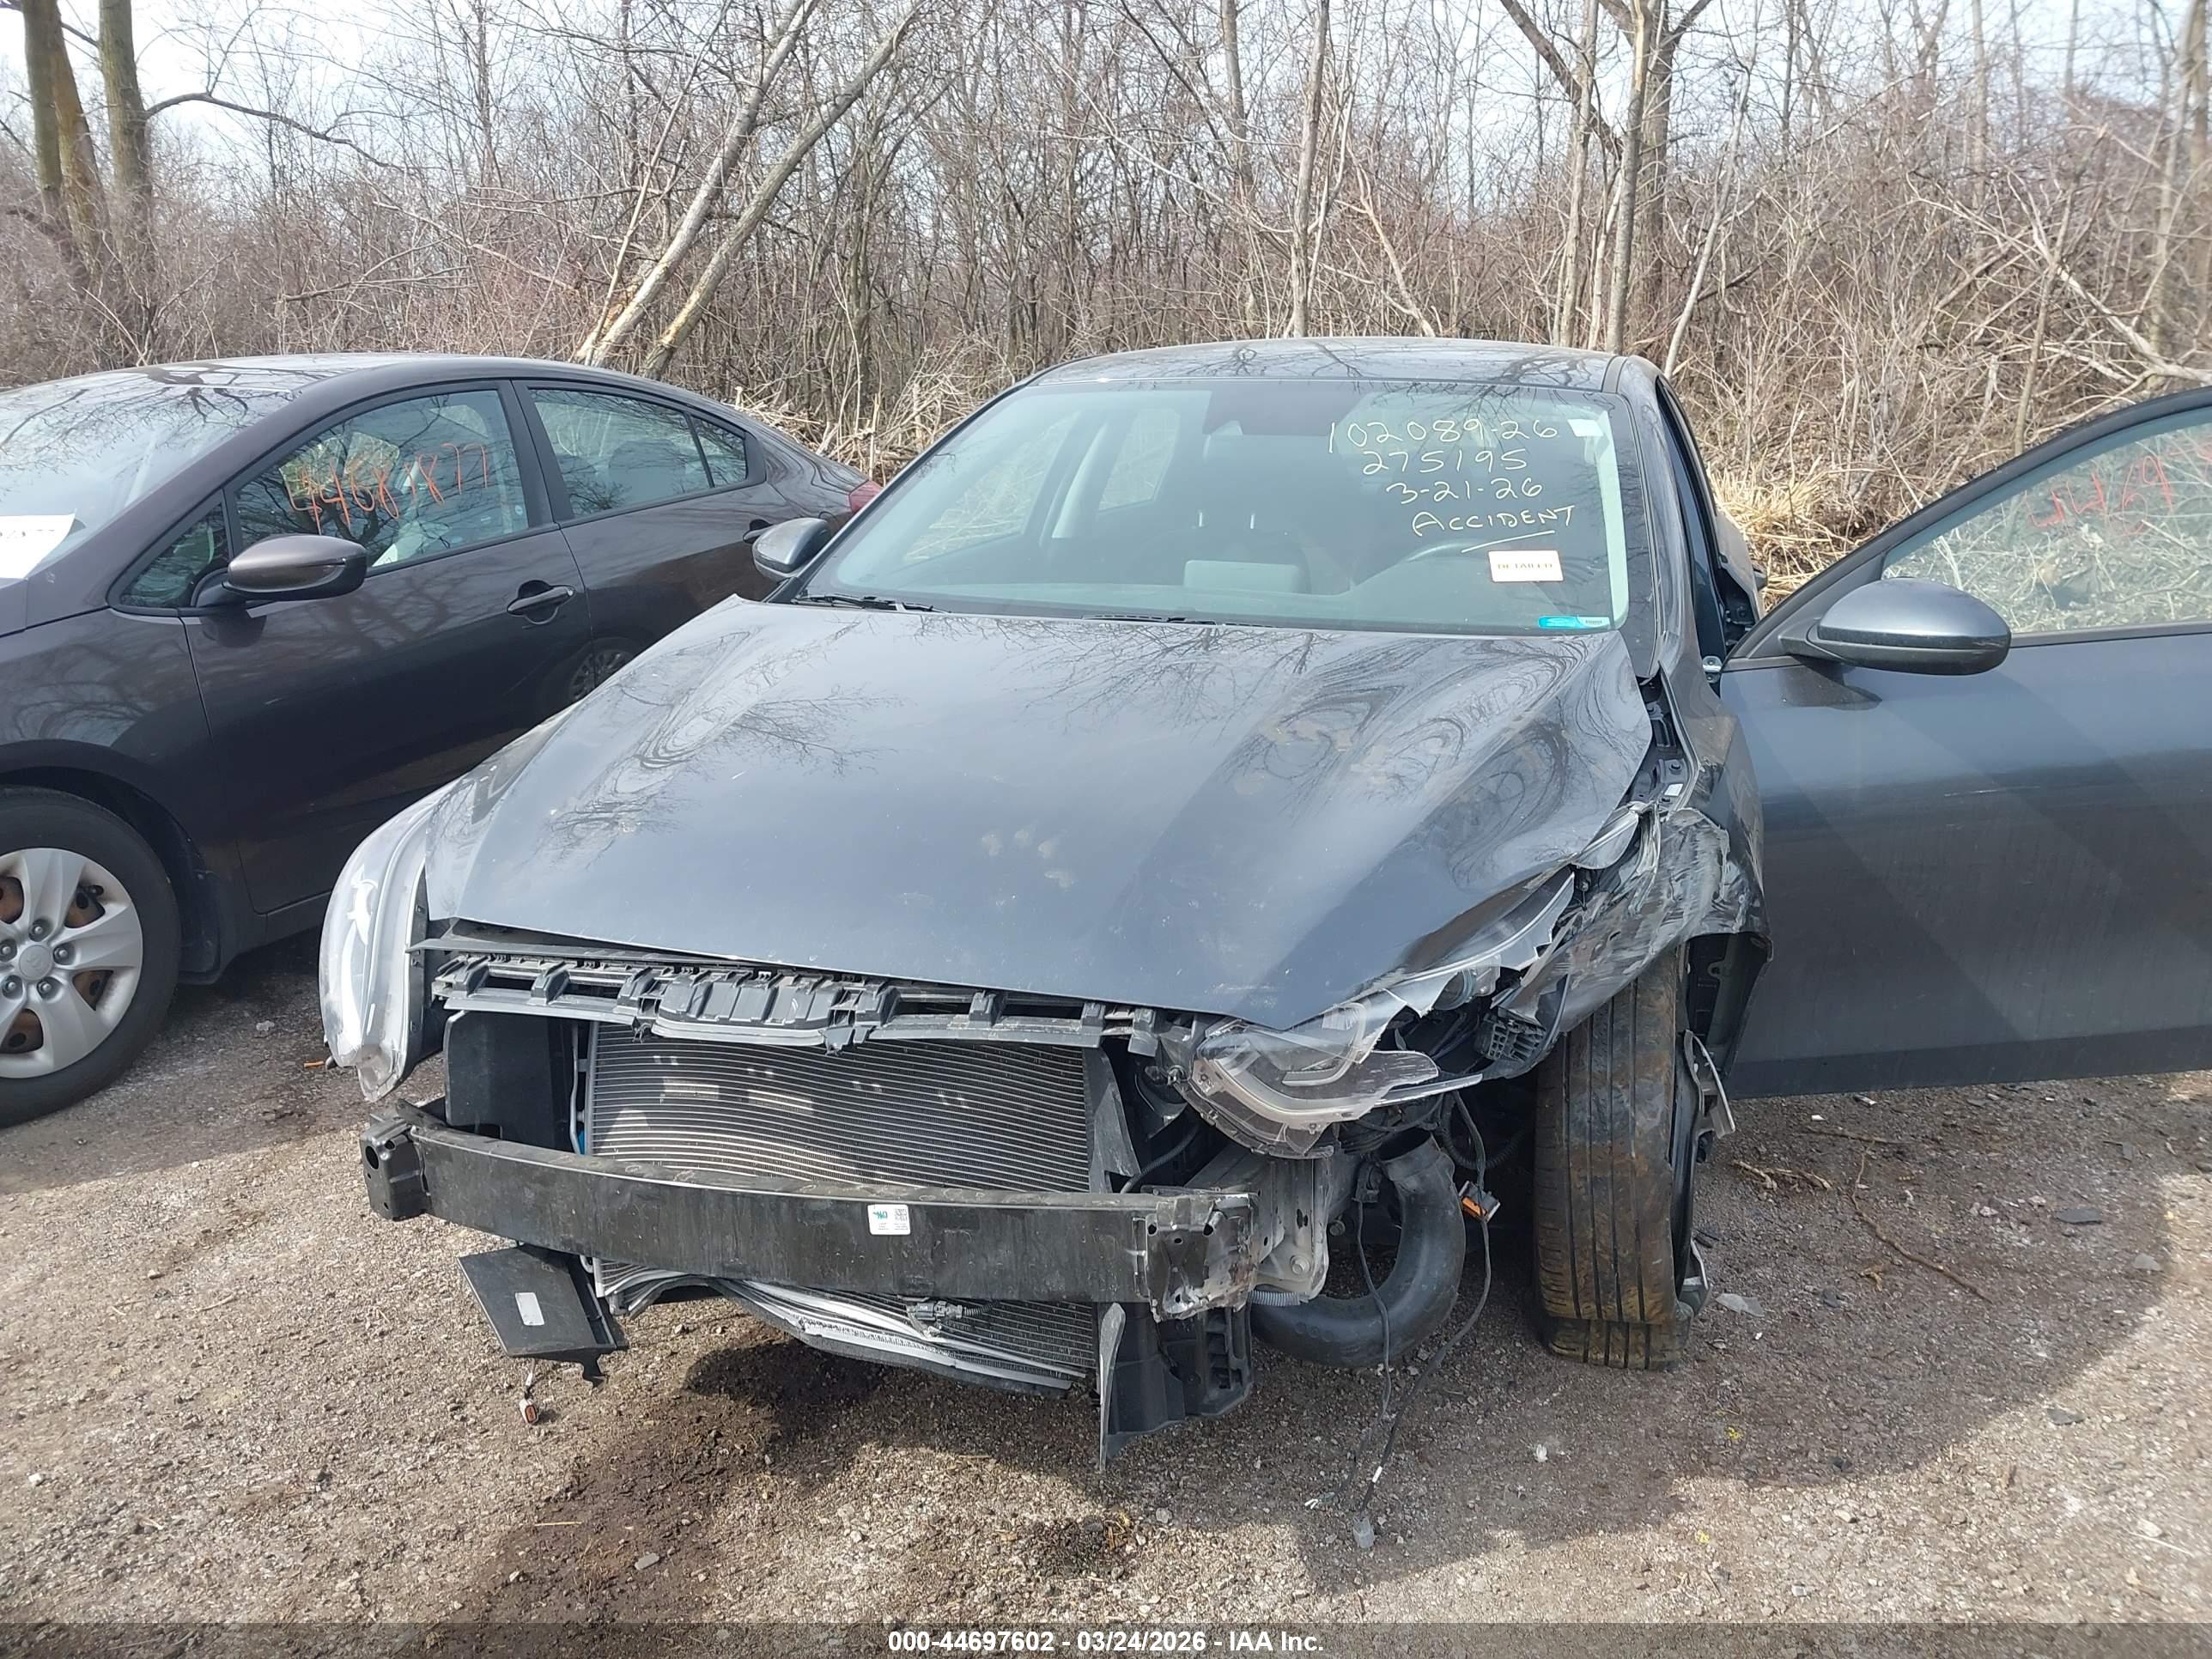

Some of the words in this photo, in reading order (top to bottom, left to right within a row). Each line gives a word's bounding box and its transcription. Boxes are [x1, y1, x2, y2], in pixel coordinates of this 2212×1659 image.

[1328, 417, 1559, 453] 102089-26
[1362, 448, 1528, 475] 275195
[1386, 477, 1544, 505] 3-21-26
[1412, 505, 1576, 536] ACCIDENT
